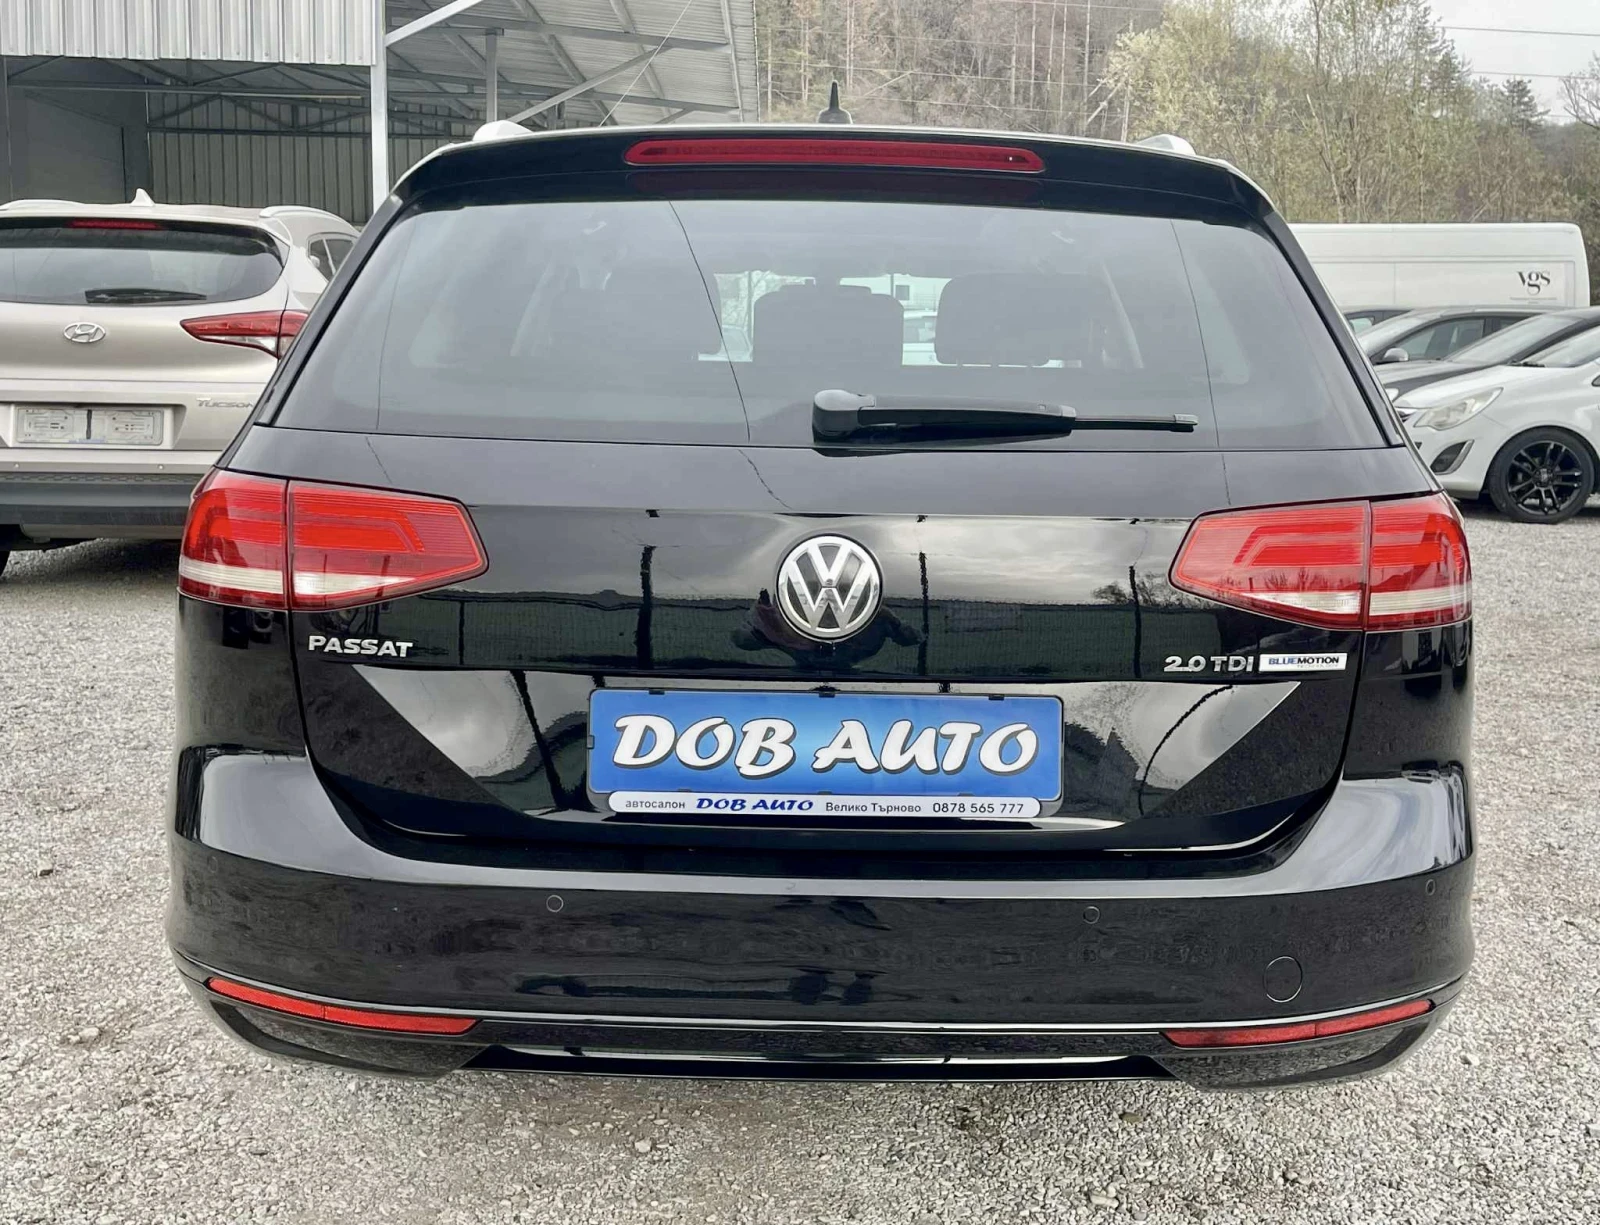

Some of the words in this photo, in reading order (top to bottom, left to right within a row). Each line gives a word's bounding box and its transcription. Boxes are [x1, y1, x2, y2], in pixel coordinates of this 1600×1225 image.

[308, 635, 413, 657] PASSAT
[1164, 655, 1206, 672] 2.0
[1211, 655, 1255, 672] TDI
[1268, 656, 1339, 665] BLUEMOTION
[613, 714, 796, 777] DOB
[812, 719, 1038, 774] AUTO
[625, 799, 686, 809] автосалон
[696, 798, 746, 811] DOB
[752, 799, 814, 811] AUTO
[825, 802, 868, 812] Велико
[871, 803, 922, 814] Търново
[932, 802, 966, 813] 0878
[970, 803, 995, 814] 565
[1000, 804, 1024, 814] 777
